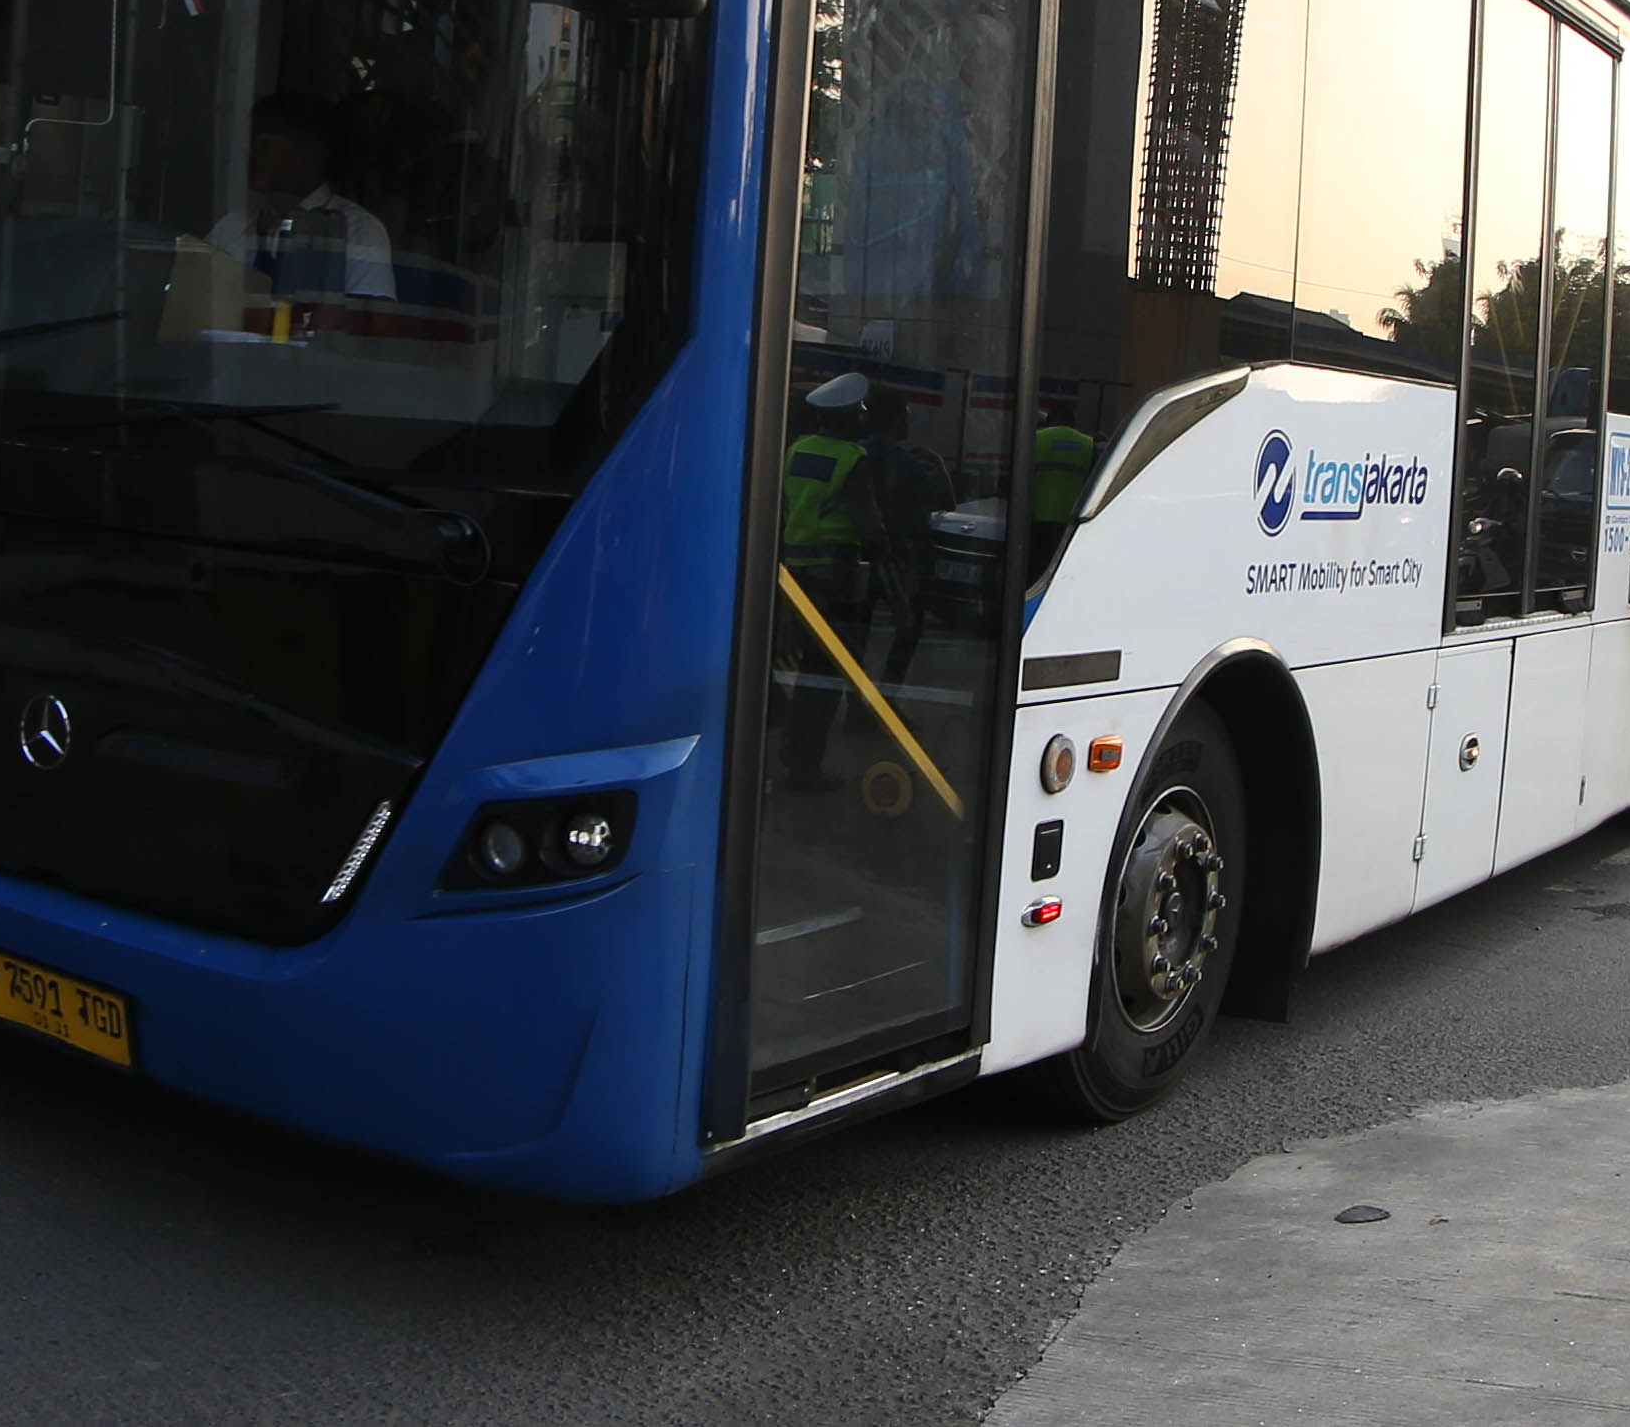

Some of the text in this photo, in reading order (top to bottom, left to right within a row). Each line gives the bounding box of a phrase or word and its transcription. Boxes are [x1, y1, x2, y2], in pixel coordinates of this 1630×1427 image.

[1301, 449, 1428, 520] transjakarta
[1246, 557, 1423, 594] SMART Mobility for Smart City
[4, 961, 63, 1018] 7591
[75, 988, 122, 1039] TGD
